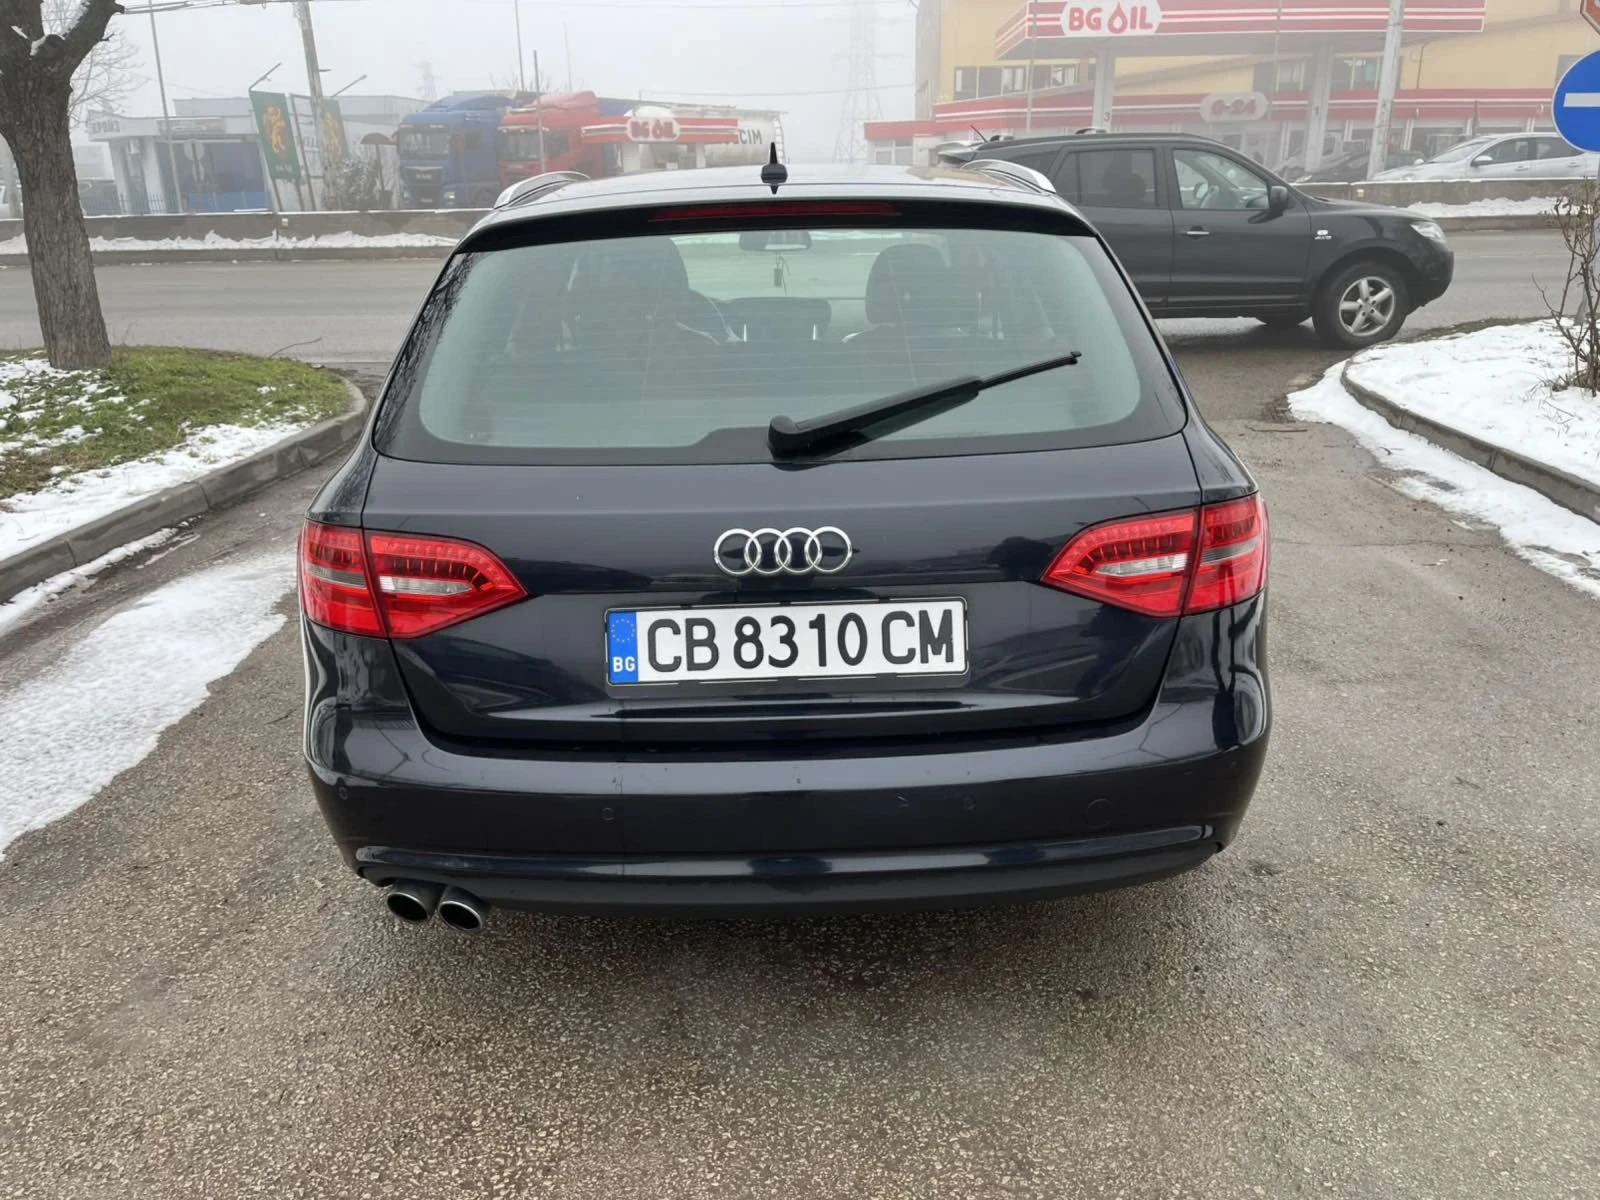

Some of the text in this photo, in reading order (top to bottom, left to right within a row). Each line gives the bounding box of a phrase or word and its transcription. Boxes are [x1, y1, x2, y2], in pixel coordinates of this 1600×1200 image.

[1069, 2, 1153, 34] BG OIL
[647, 609, 954, 672] CB 8310 CM
[613, 656, 635, 672] BG
